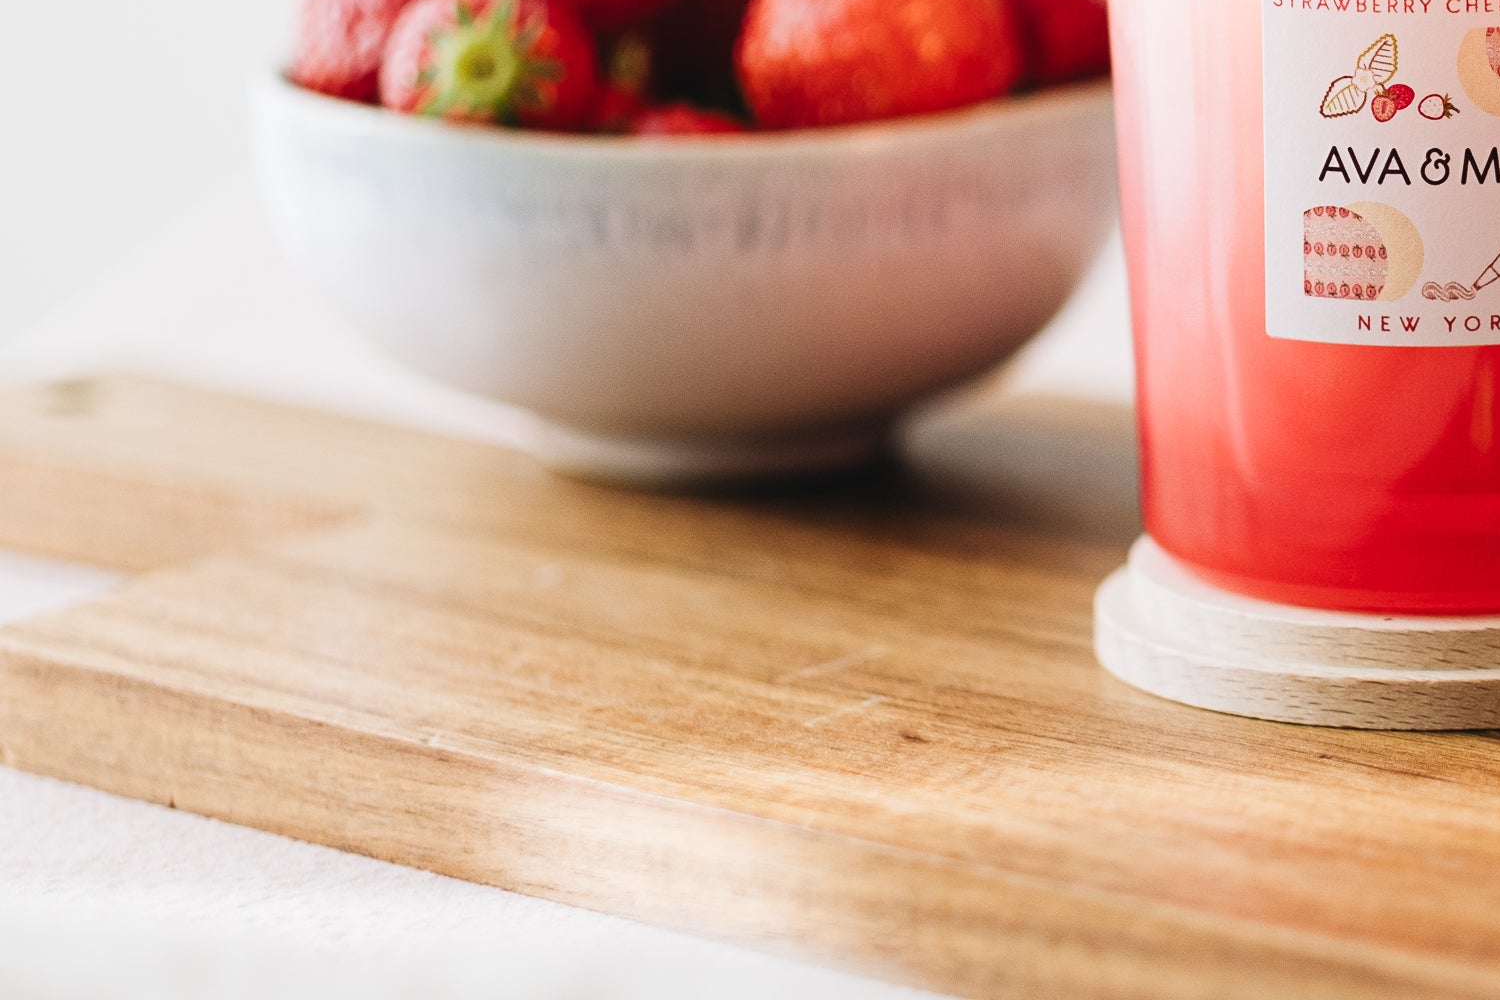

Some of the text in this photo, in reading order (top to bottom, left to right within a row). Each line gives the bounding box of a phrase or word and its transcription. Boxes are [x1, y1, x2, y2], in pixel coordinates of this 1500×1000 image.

[1318, 145, 1412, 186] AVA
[1420, 147, 1450, 186] &
[1357, 314, 1421, 332] NEW
